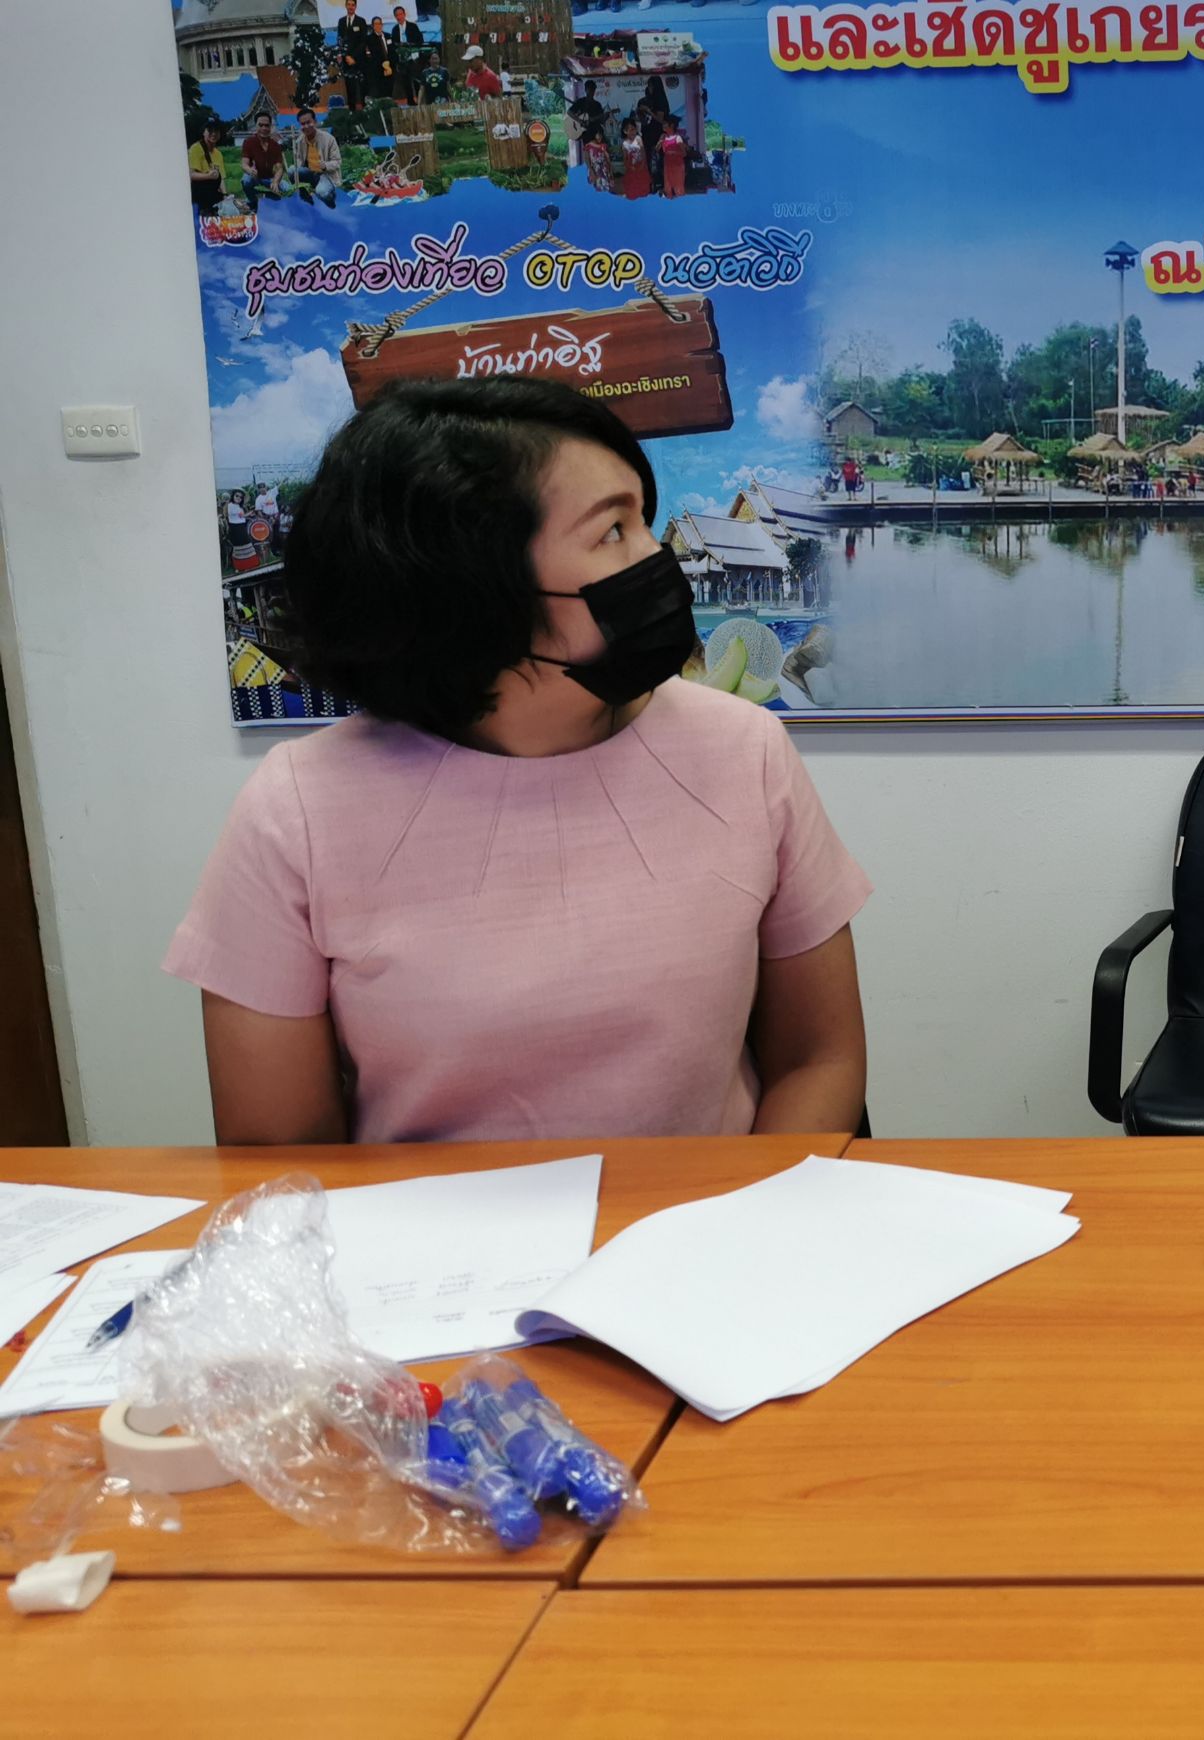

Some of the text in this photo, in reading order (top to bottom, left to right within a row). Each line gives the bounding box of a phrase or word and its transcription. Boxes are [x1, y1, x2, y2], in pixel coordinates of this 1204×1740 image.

[247, 223, 811, 317] ชุมชนท่องเที่ยว OTOP นวัตวิถี
[1151, 249, 1202, 284] ณ
[457, 325, 611, 379] บ้านท่าอิฐ
